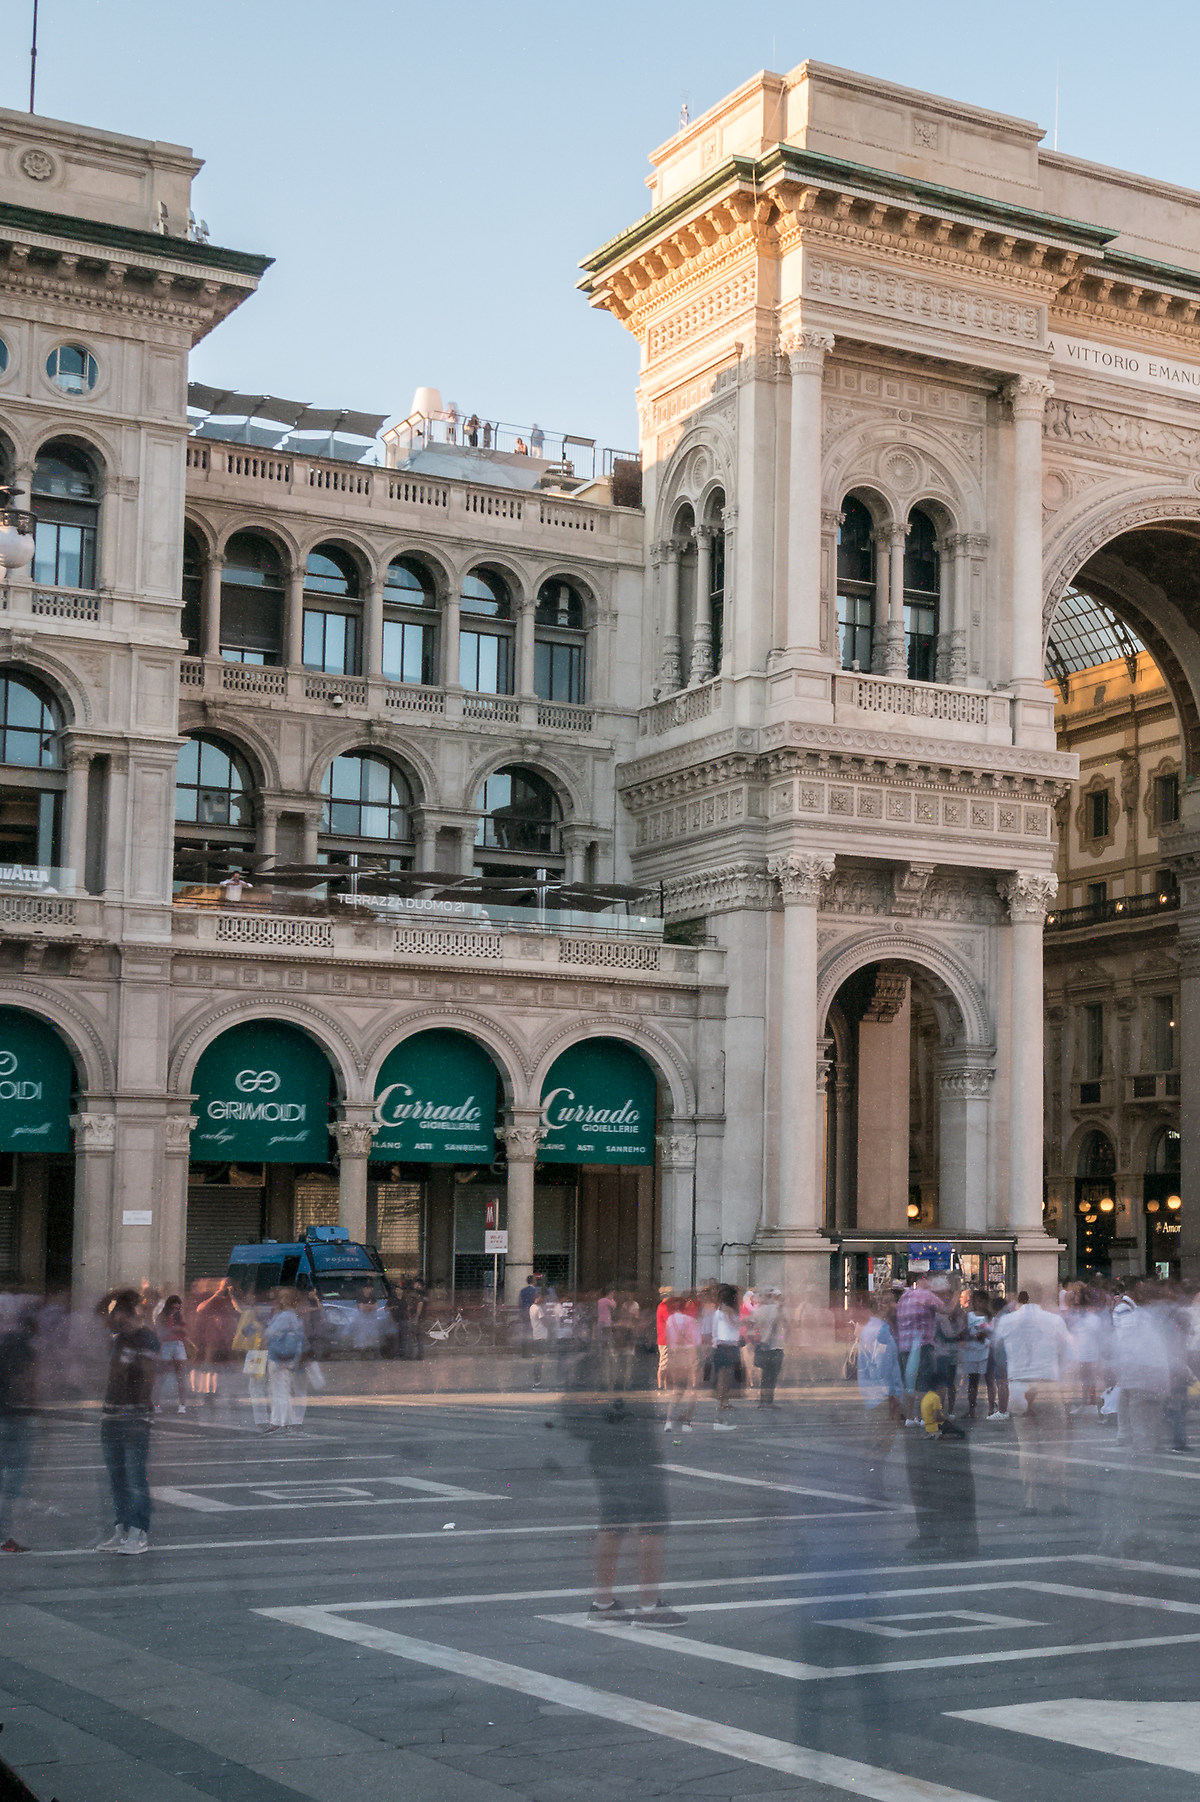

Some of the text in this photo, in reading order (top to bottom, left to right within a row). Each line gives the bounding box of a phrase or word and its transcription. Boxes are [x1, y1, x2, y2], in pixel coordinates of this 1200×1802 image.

[1047, 340, 1056, 352] A
[1067, 343, 1140, 372] VITTORIO
[0, 864, 49, 882] VAZZA
[337, 893, 465, 913] TERRAZZA DUOMO 21
[207, 1100, 307, 1122] GRIMOLDI
[374, 1083, 482, 1127] Currado
[541, 1087, 640, 1130] Currado
[419, 1121, 481, 1131] GIOIELLERIE
[581, 1124, 640, 1134] GIOIELLERIE
[444, 1143, 489, 1152] SANREMO
[576, 1144, 595, 1152] ASTI
[605, 1145, 646, 1153] SANREMO
[486, 1206, 494, 1223] M
